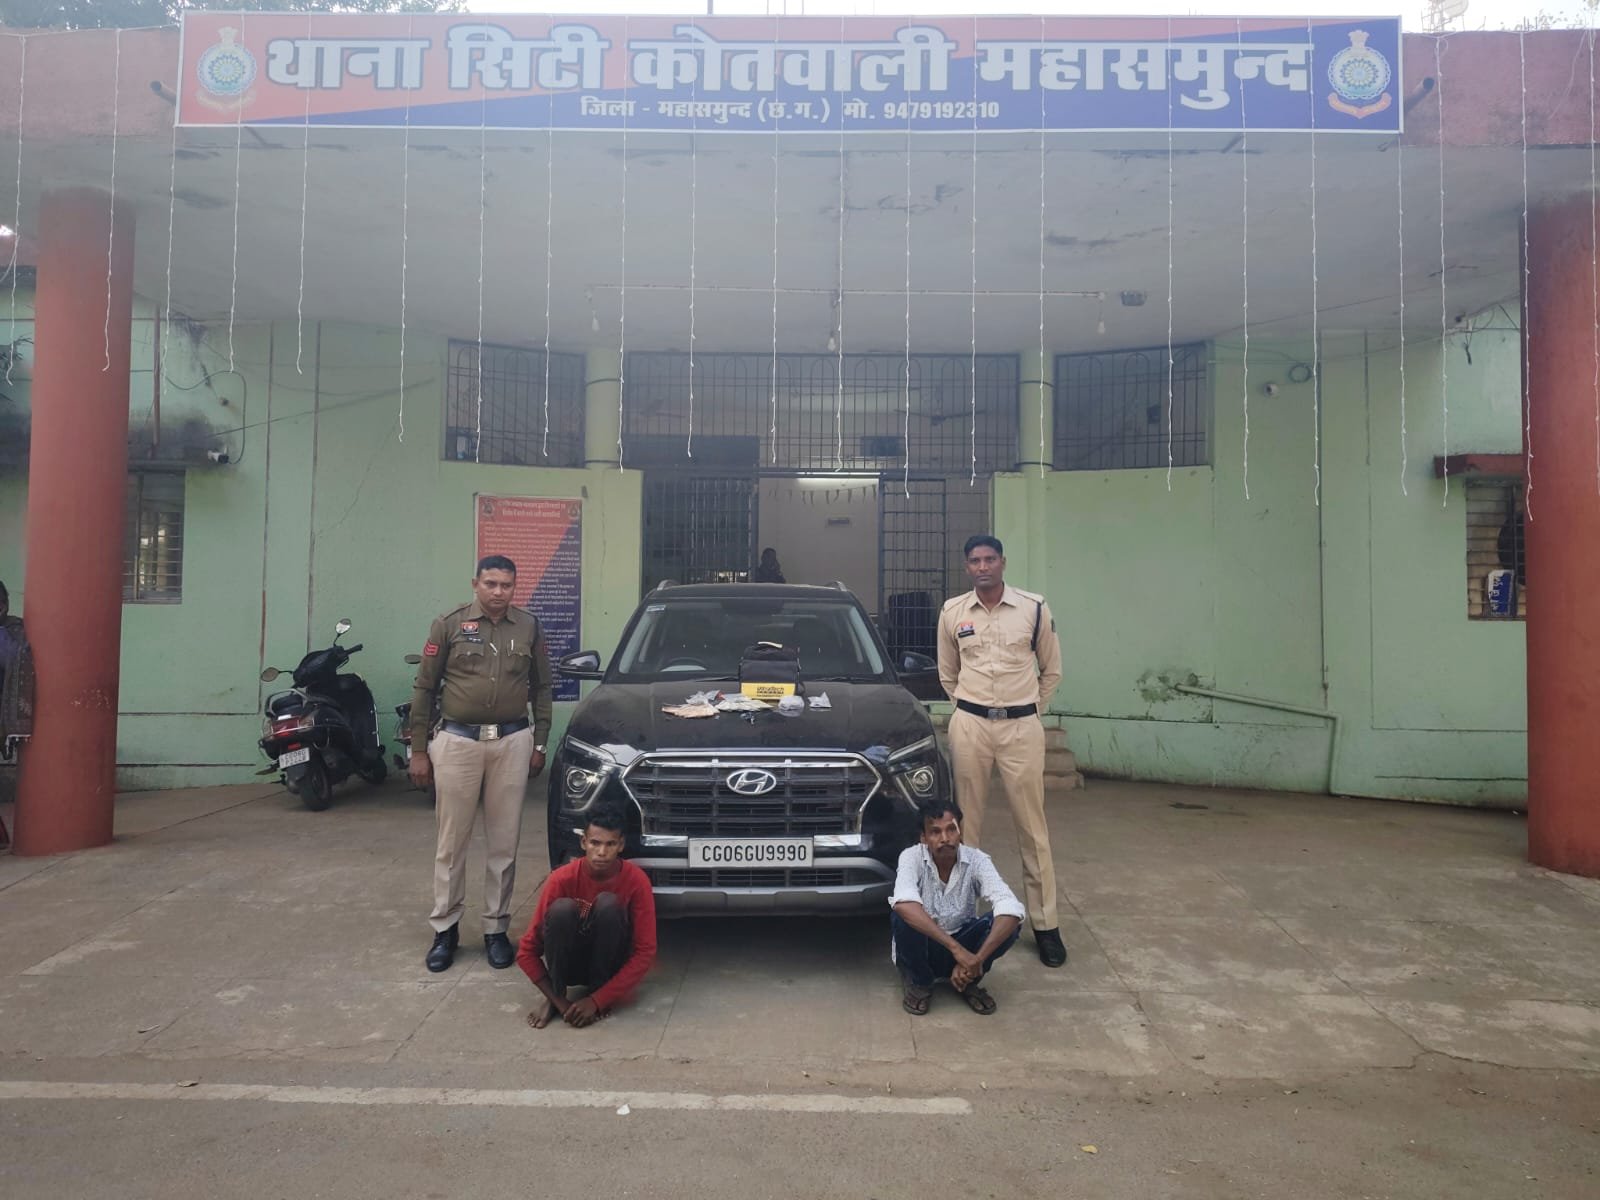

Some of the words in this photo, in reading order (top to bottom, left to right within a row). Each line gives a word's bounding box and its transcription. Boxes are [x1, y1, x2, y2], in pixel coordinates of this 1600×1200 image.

[267, 38, 430, 89] थाना
[447, 22, 611, 89] सिटी
[628, 24, 957, 92] कोतवाली
[976, 42, 1315, 111] महासमुन्द
[580, 95, 637, 117] जिला
[657, 100, 753, 124] महासमुन्द
[843, 98, 876, 119] मो.
[883, 101, 1000, 119] 9479192310
[701, 844, 808, 862] CG06GU9990
